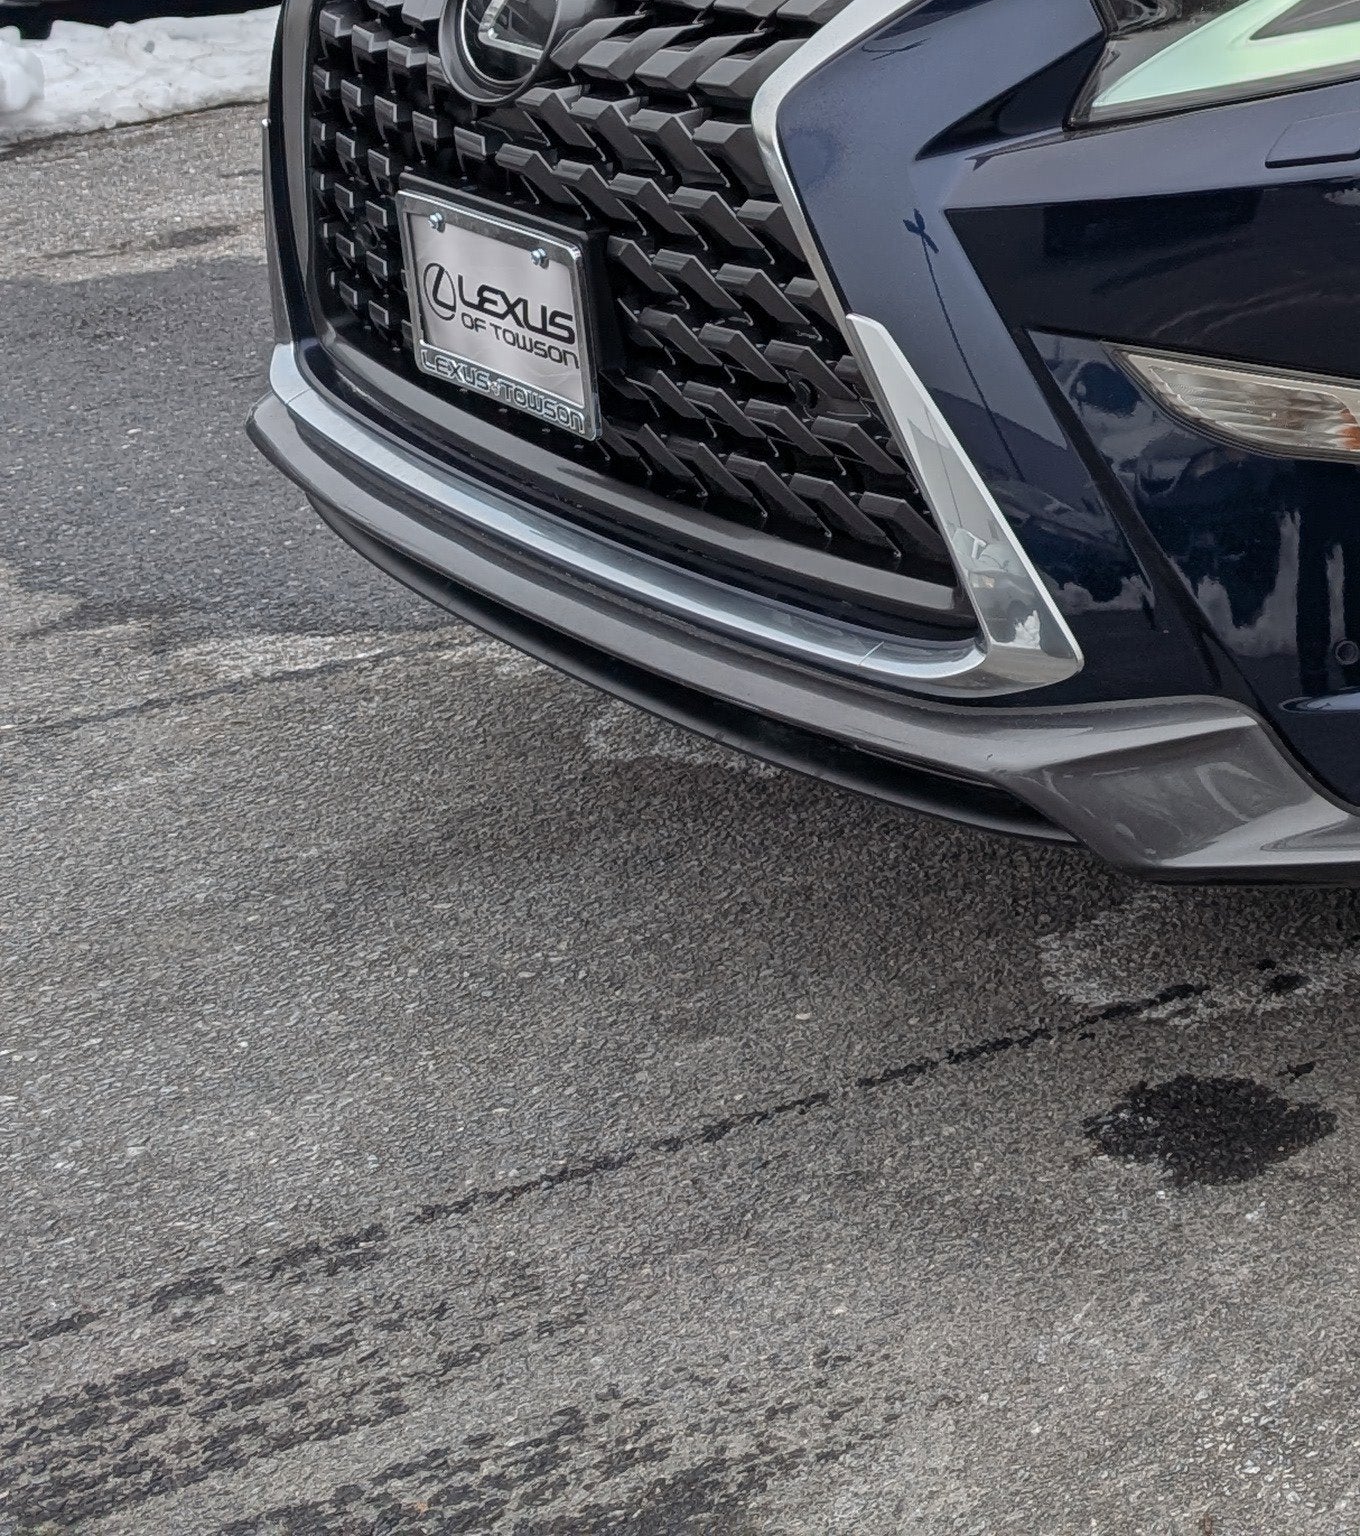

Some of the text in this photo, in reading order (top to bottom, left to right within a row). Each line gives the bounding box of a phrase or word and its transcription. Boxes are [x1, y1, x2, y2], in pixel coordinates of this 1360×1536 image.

[457, 274, 576, 345] LEXUS
[461, 312, 580, 370] OF TOWSON
[420, 349, 586, 434] LEXUS TOWSON
